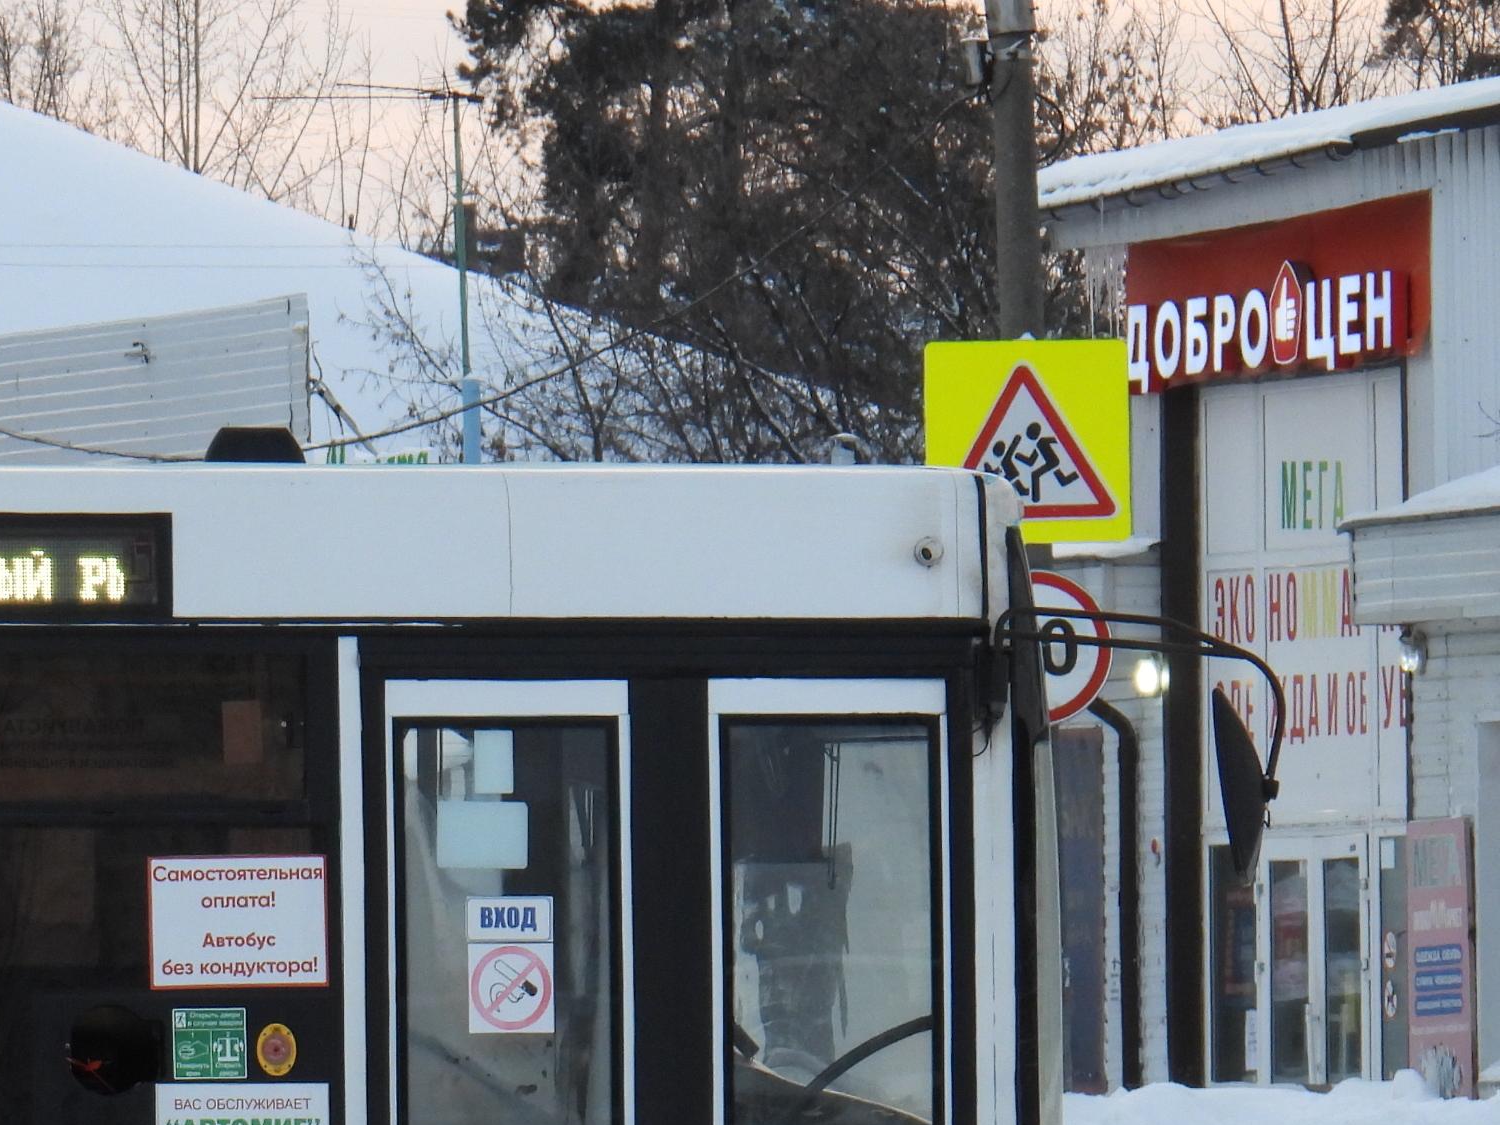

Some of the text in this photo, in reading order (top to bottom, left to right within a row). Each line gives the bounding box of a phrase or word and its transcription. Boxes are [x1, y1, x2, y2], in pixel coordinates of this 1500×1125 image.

[1282, 461, 1345, 529] МЕГА
[1041, 618, 1078, 676] 0
[152, 865, 323, 882] Самостоятельная
[200, 891, 276, 908] оплата!
[480, 906, 538, 932] ВХОД
[202, 932, 276, 950] Автобус
[162, 957, 318, 977] без кондуктора!
[174, 1097, 311, 1110] ВАС ОБСЛУЖИВАЕТ
